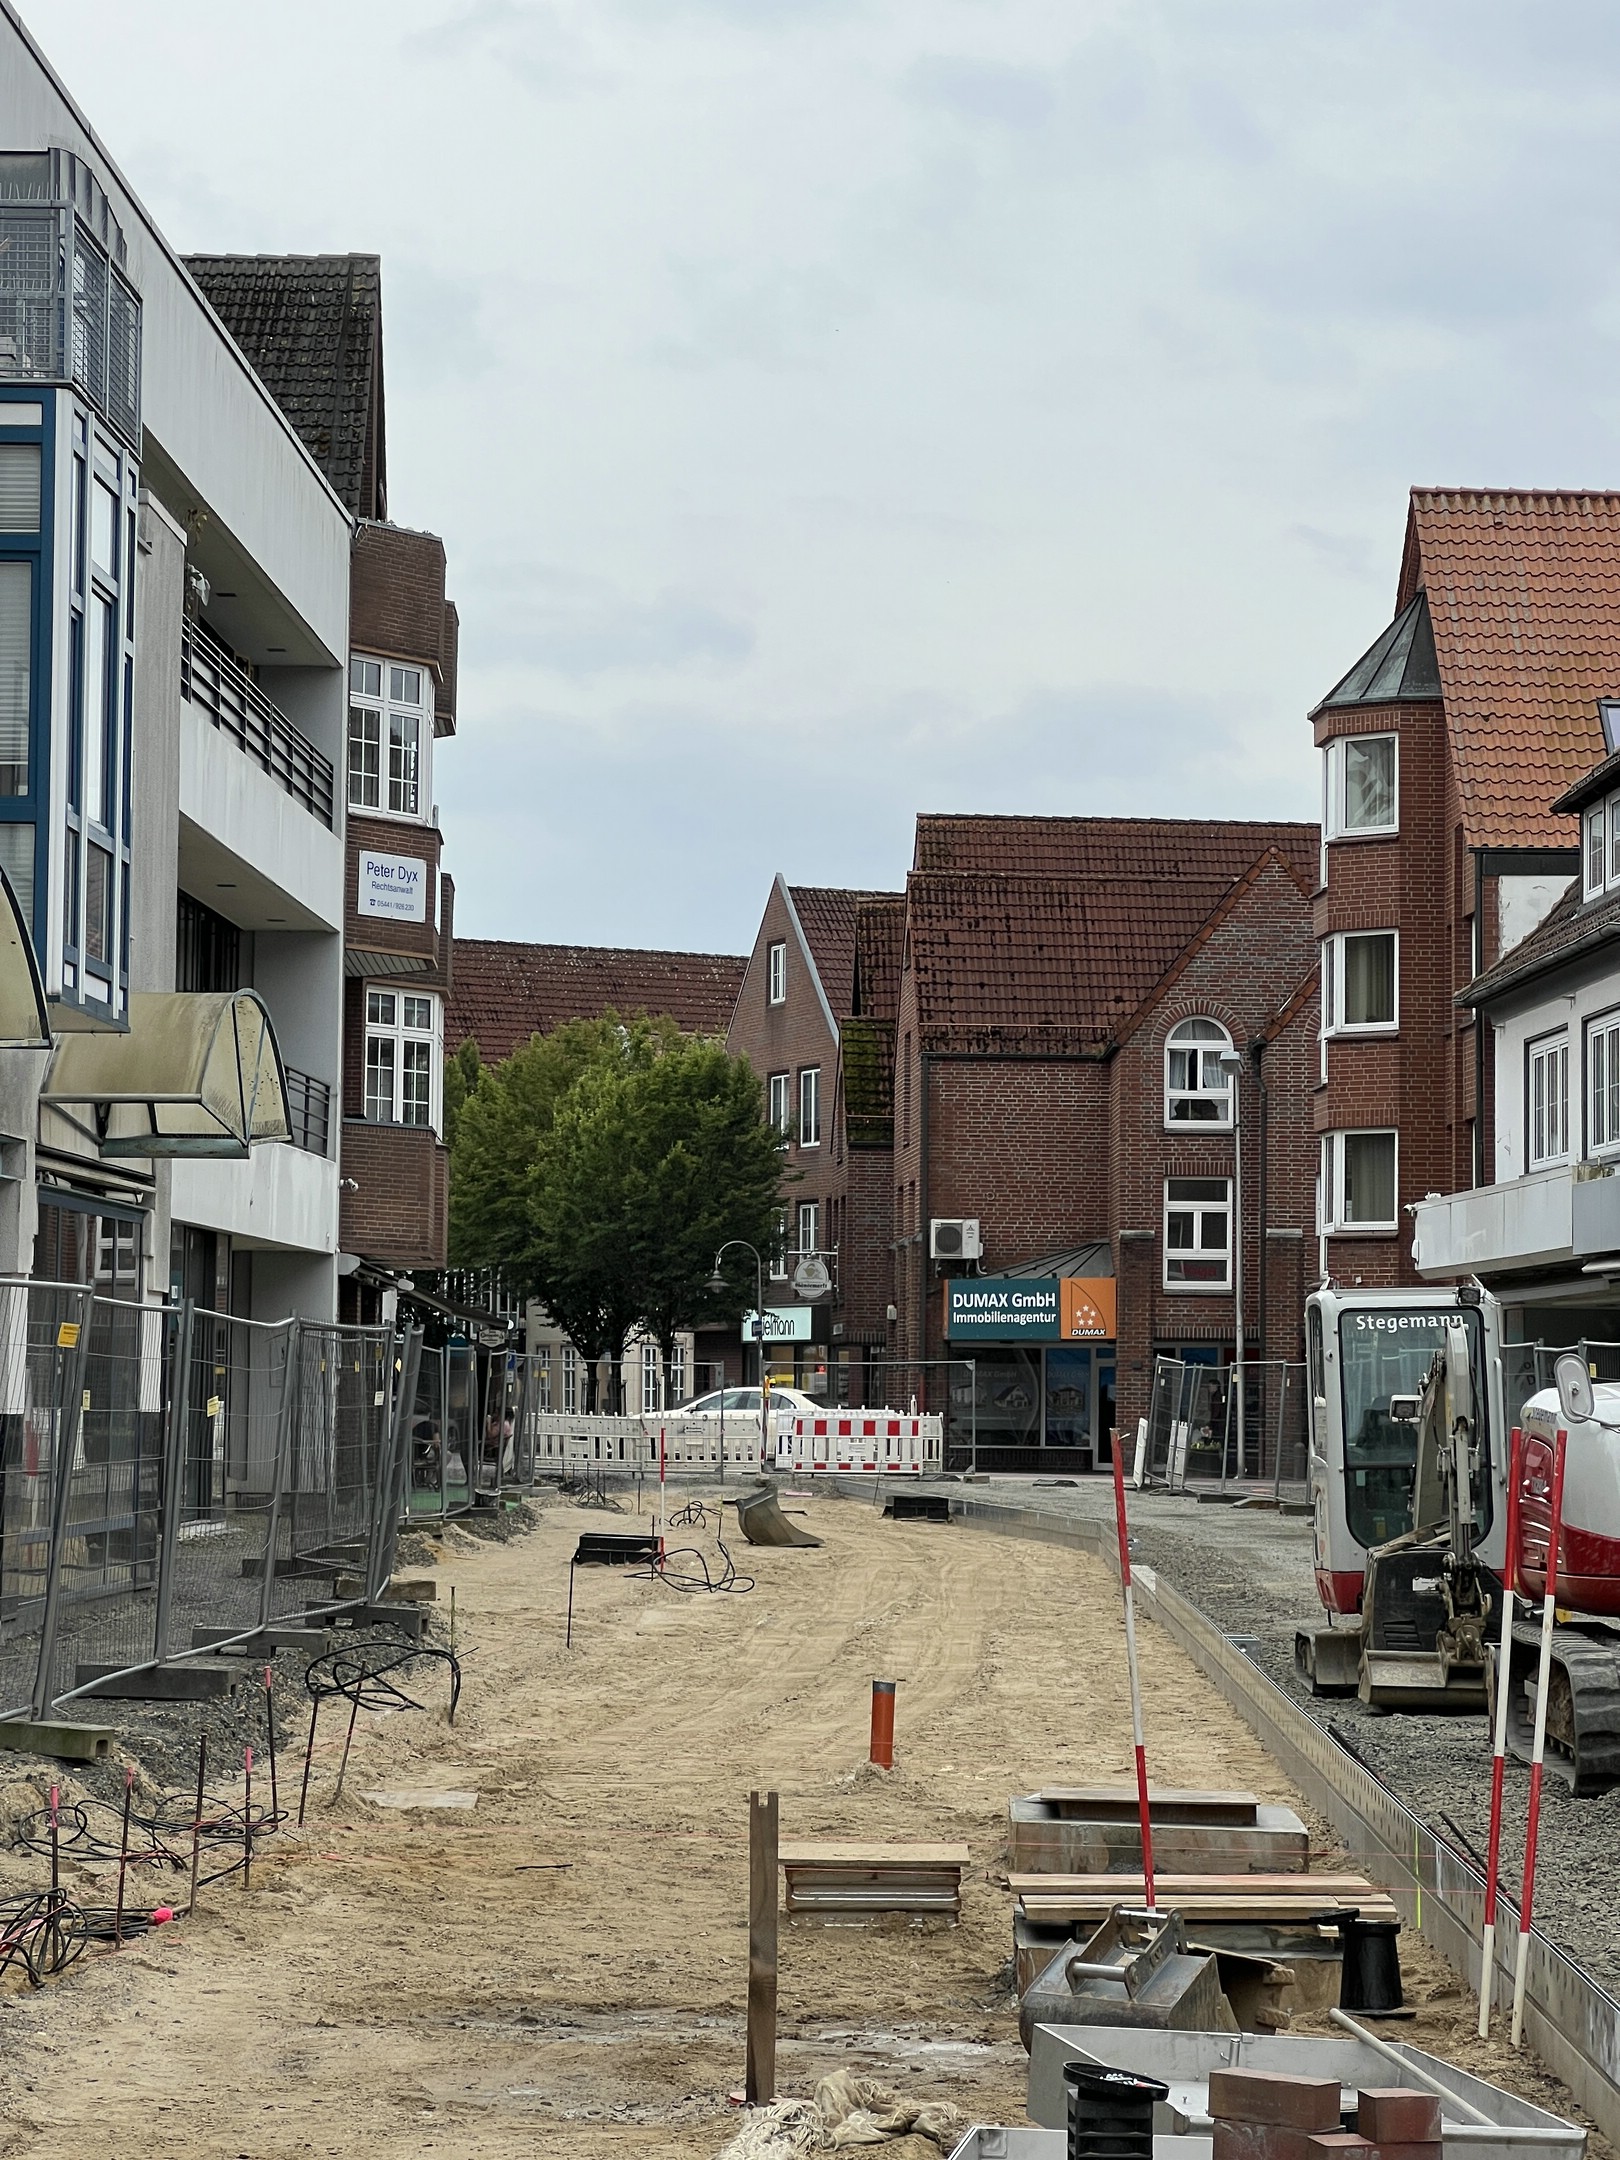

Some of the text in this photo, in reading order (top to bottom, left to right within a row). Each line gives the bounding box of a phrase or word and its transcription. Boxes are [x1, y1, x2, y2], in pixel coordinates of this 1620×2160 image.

[367, 861, 418, 883] Peter Dyx
[371, 881, 413, 894] Rechtsanwalt
[953, 1292, 1056, 1308] DUMAX GmbH
[953, 1311, 1056, 1325] Immobilienagentur
[1356, 1315, 1463, 1333] Stegemann
